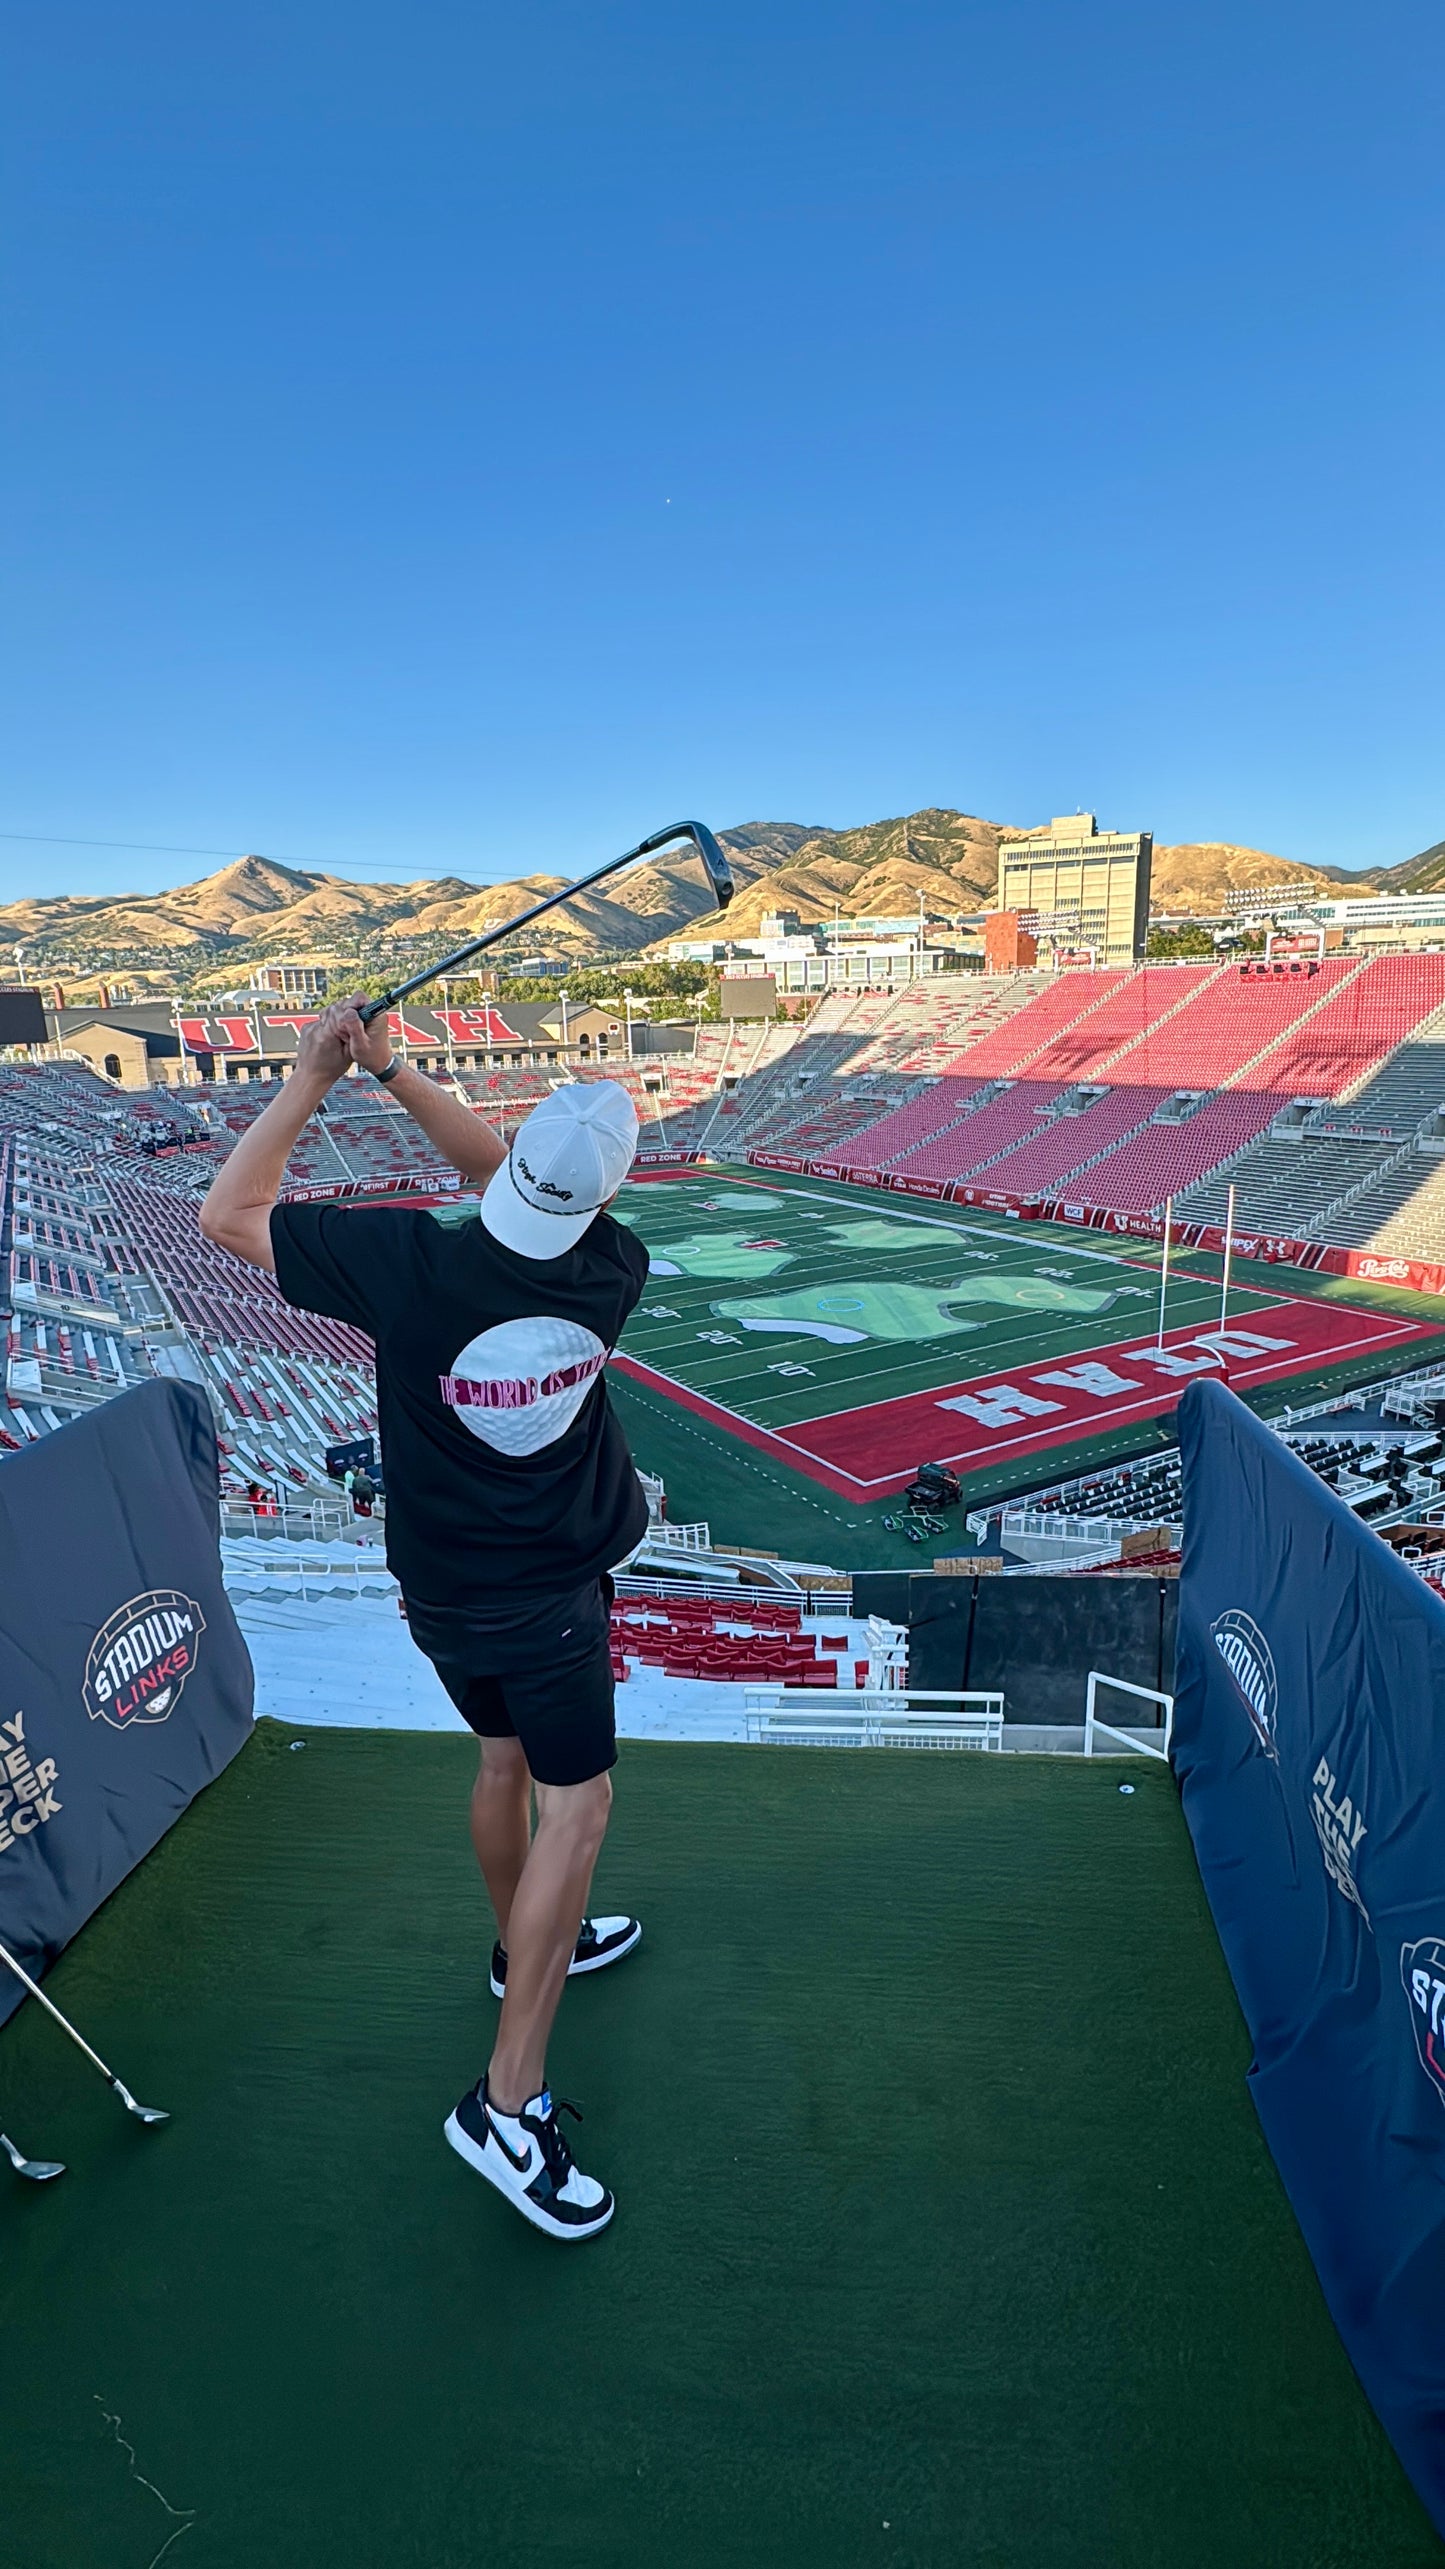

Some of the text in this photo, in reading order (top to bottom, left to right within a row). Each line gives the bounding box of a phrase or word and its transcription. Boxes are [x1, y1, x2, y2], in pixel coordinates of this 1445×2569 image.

[640, 1153, 682, 1163] RED ZONE
[415, 1178, 434, 1187] RD
[293, 1188, 335, 1201] RED ZONE
[1066, 1206, 1083, 1217] WCF
[1129, 1219, 1162, 1233] HEALTH
[641, 1305, 678, 1319] 30
[696, 1329, 738, 1345] 20
[766, 1361, 810, 1377] 10
[933, 1330, 1300, 1429] UTAH
[438, 1375, 460, 1406] THE
[467, 1376, 538, 1409] WORLD
[549, 1368, 565, 1395] IS
[94, 1611, 194, 1702] STADIUM
[115, 1645, 189, 1718] LINKS
[1312, 1755, 1368, 1850] PLAY
[1412, 1968, 1445, 2048] ST
